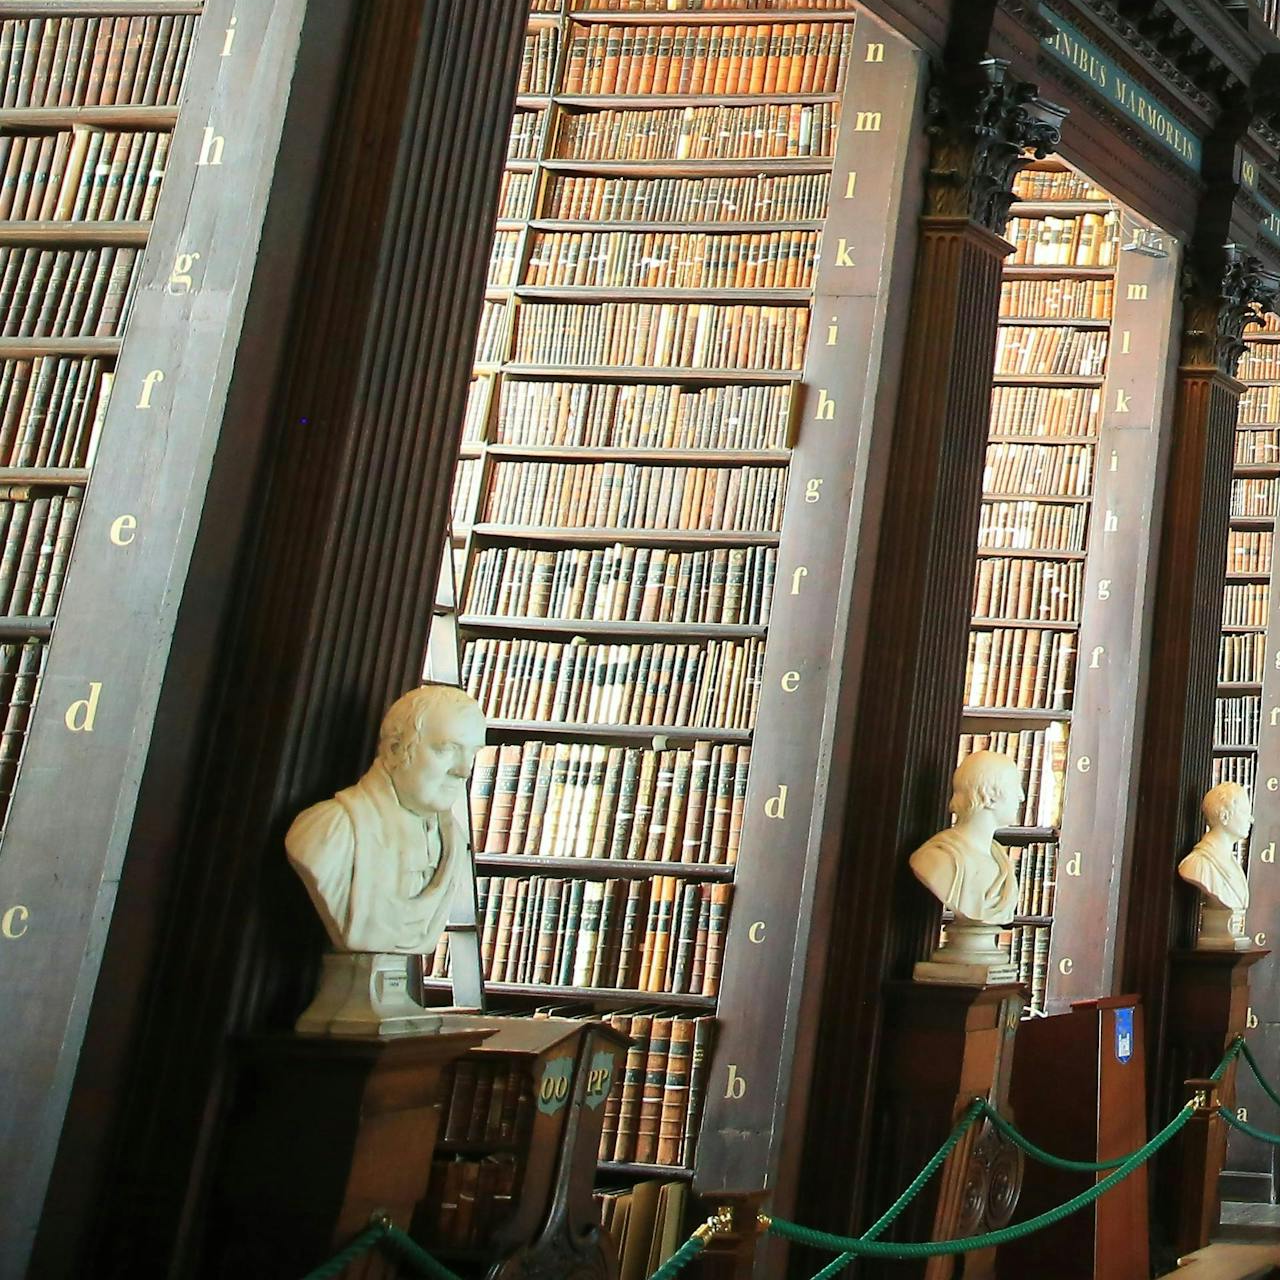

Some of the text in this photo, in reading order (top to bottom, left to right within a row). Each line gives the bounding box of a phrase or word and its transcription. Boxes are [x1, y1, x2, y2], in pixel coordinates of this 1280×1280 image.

[220, 15, 236, 56] i
[865, 43, 884, 62] n
[854, 110, 881, 132] m
[1115, 77, 1194, 163] MARMOREIS
[195, 121, 224, 166] h
[845, 172, 856, 198] l
[835, 239, 854, 266] k
[166, 248, 203, 296] g
[1127, 284, 1148, 300] m
[826, 317, 837, 345] i
[1121, 331, 1130, 354] l
[136, 370, 163, 408] f
[815, 390, 834, 419] h
[1115, 390, 1132, 412] k
[1109, 451, 1118, 472] i
[806, 479, 823, 502] g
[111, 515, 136, 545] e
[1104, 510, 1118, 532] h
[791, 567, 807, 594] f
[1098, 579, 1111, 600] g
[1089, 647, 1104, 668] f
[781, 671, 800, 692] e
[66, 683, 102, 731] d
[1270, 707, 1280, 726] f
[1077, 756, 1090, 772] e
[1267, 777, 1278, 790] e
[765, 785, 787, 818] d
[1066, 852, 1080, 876] d
[1261, 843, 1275, 864] d
[2, 906, 28, 938] c
[749, 921, 766, 943] c
[1254, 932, 1266, 946] c
[1060, 958, 1072, 974] c
[1246, 1008, 1258, 1028] b
[541, 1076, 568, 1100] OO
[587, 1068, 609, 1093] PP
[725, 1065, 745, 1098] b
[1237, 1107, 1248, 1122] a
